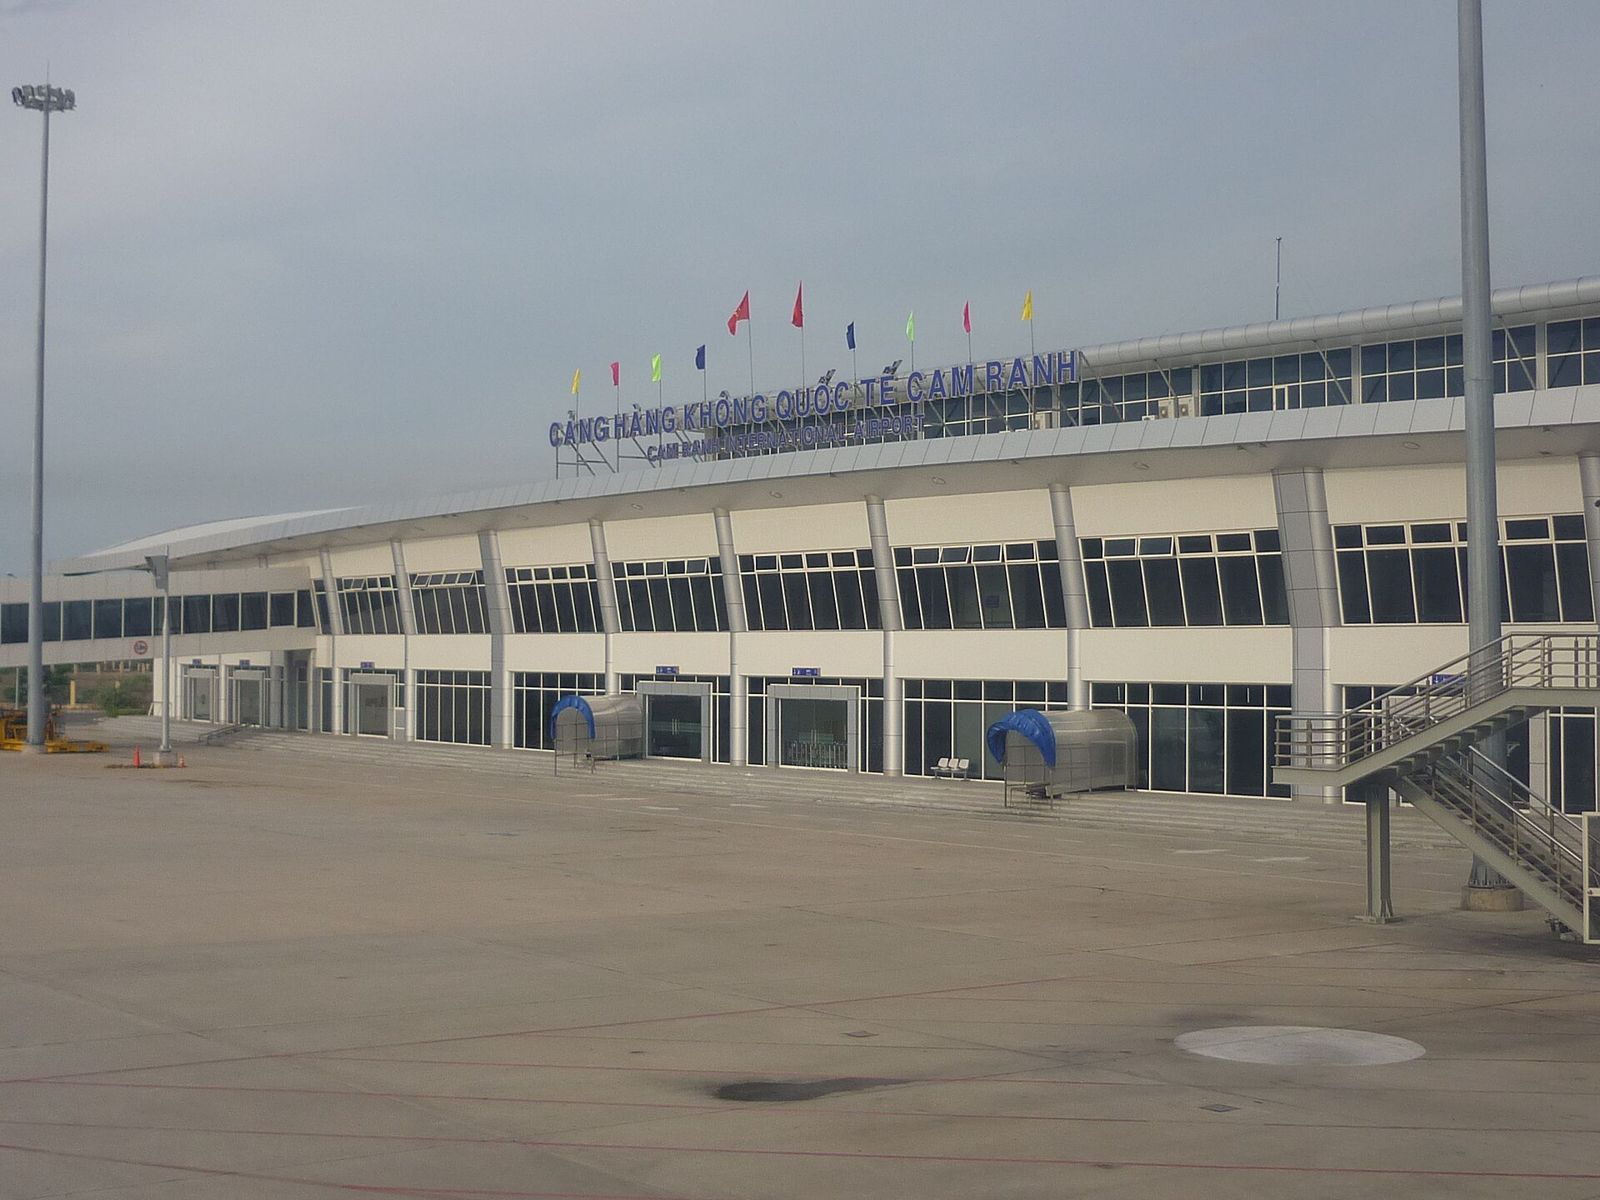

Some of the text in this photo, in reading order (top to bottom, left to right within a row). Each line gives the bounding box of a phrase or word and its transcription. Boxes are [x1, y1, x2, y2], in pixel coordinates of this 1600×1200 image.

[614, 403, 676, 439] HÀNG
[684, 390, 767, 431] KHÔNG
[775, 369, 849, 420] QUỐC
[860, 359, 903, 408] TẾ
[906, 364, 975, 403] CAM
[986, 350, 1078, 393] RANH
[647, 414, 926, 462] CAM RANH INTERNATIONAL AIRPORT
